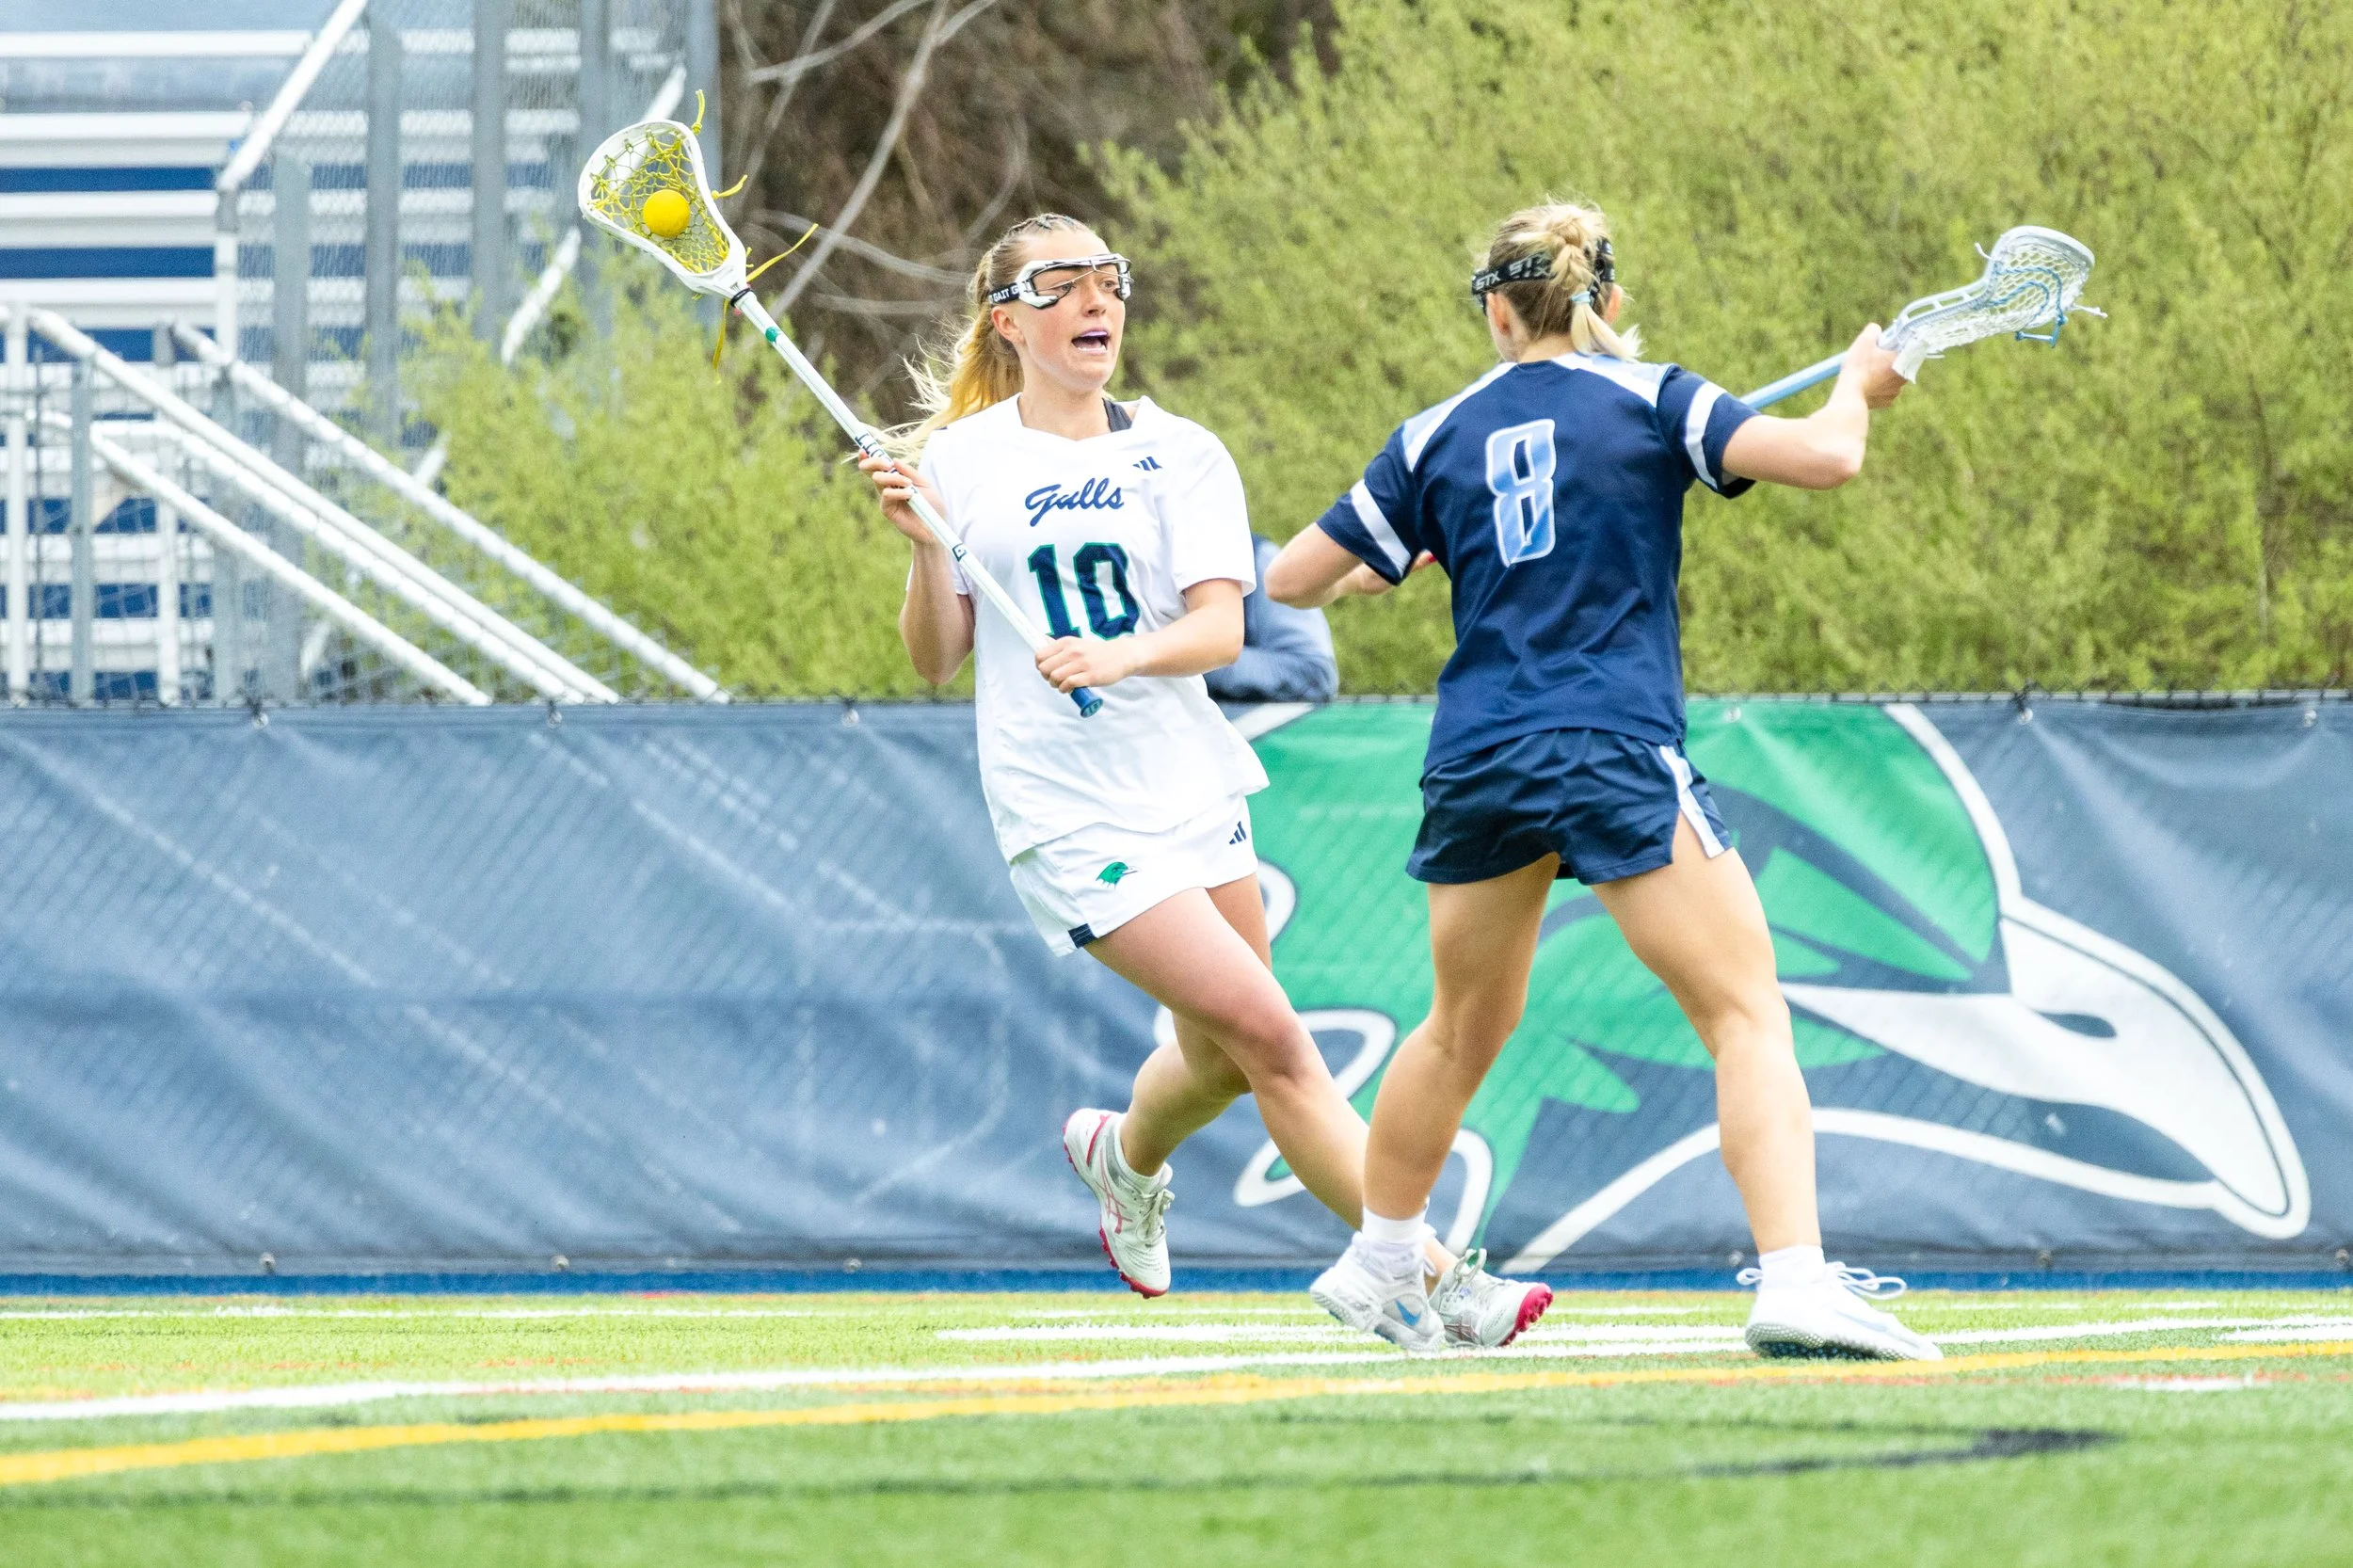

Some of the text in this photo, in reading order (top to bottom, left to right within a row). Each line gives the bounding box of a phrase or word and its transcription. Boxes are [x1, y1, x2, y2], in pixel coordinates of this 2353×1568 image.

[993, 288, 1010, 302] GAIT
[1476, 271, 1501, 291] STX
[1025, 477, 1125, 527] Gulls
[1485, 418, 1557, 568] 8
[1027, 542, 1142, 641] 10
